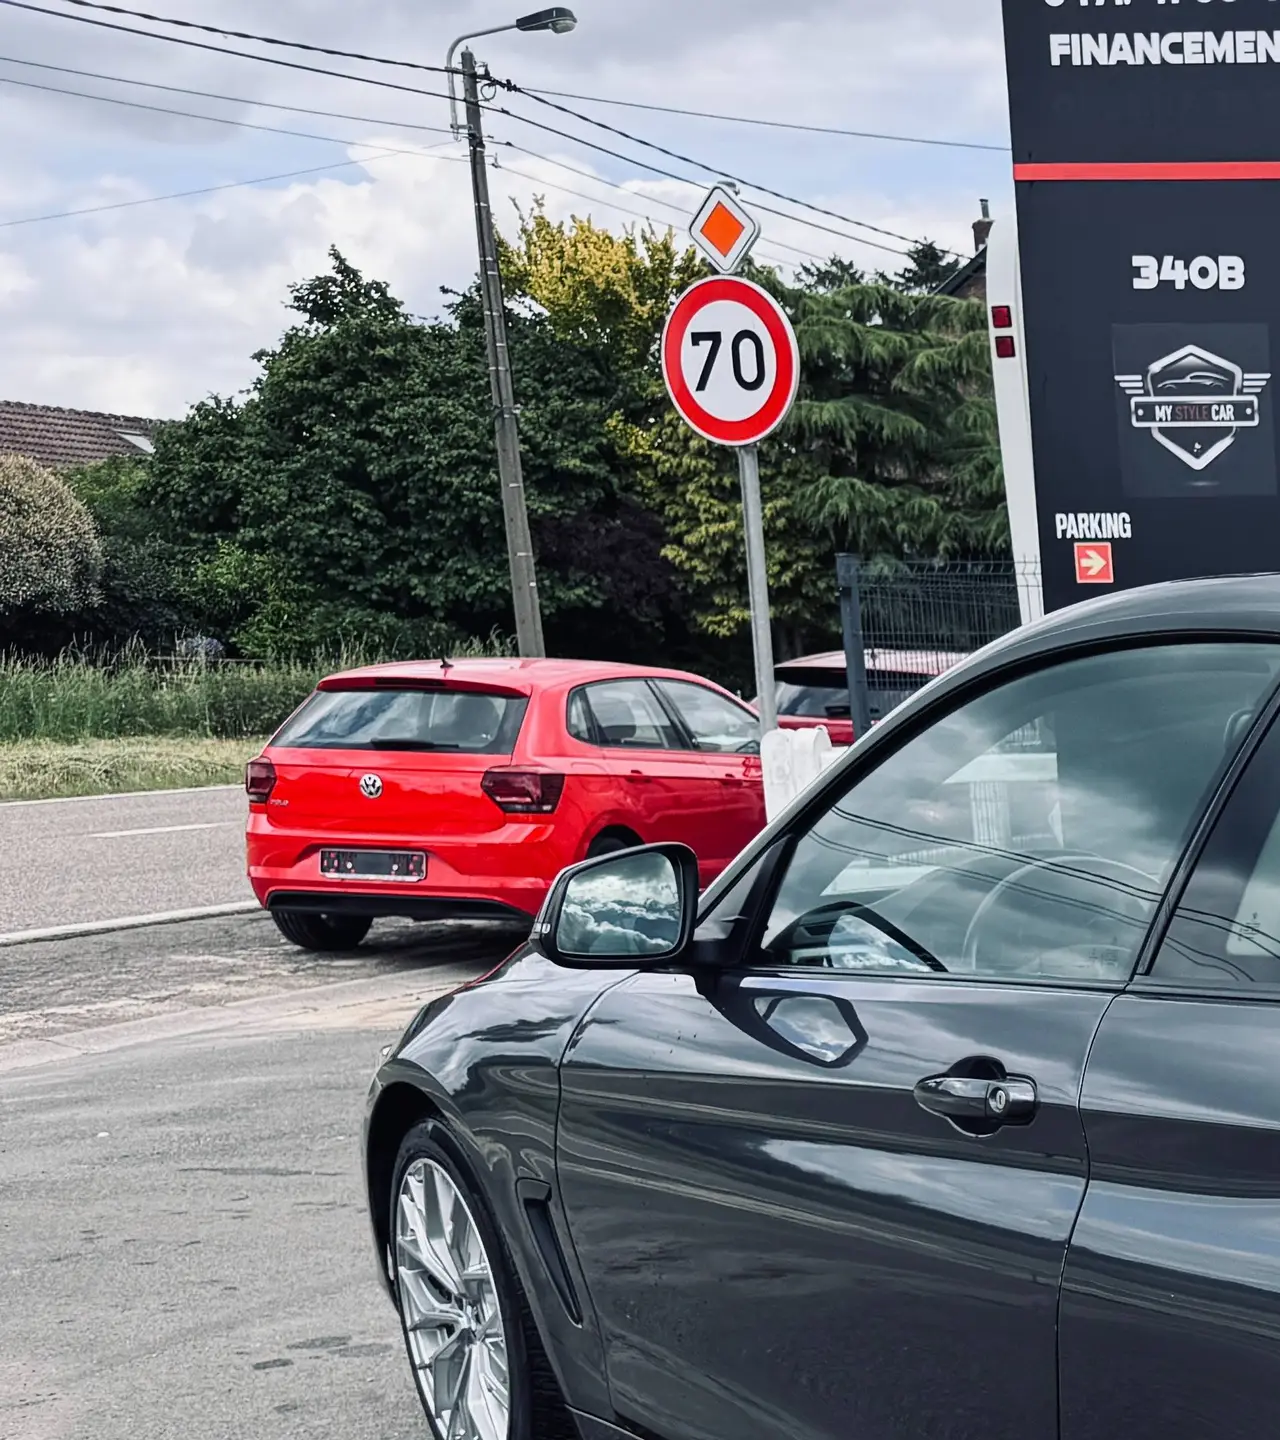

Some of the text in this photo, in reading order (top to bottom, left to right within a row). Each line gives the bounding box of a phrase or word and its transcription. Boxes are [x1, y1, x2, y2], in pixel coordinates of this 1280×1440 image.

[1131, 255, 1245, 290] 340B
[690, 329, 766, 392] 70
[1154, 404, 1235, 422] MY STYLE CAR
[1055, 512, 1132, 539] PARKING
